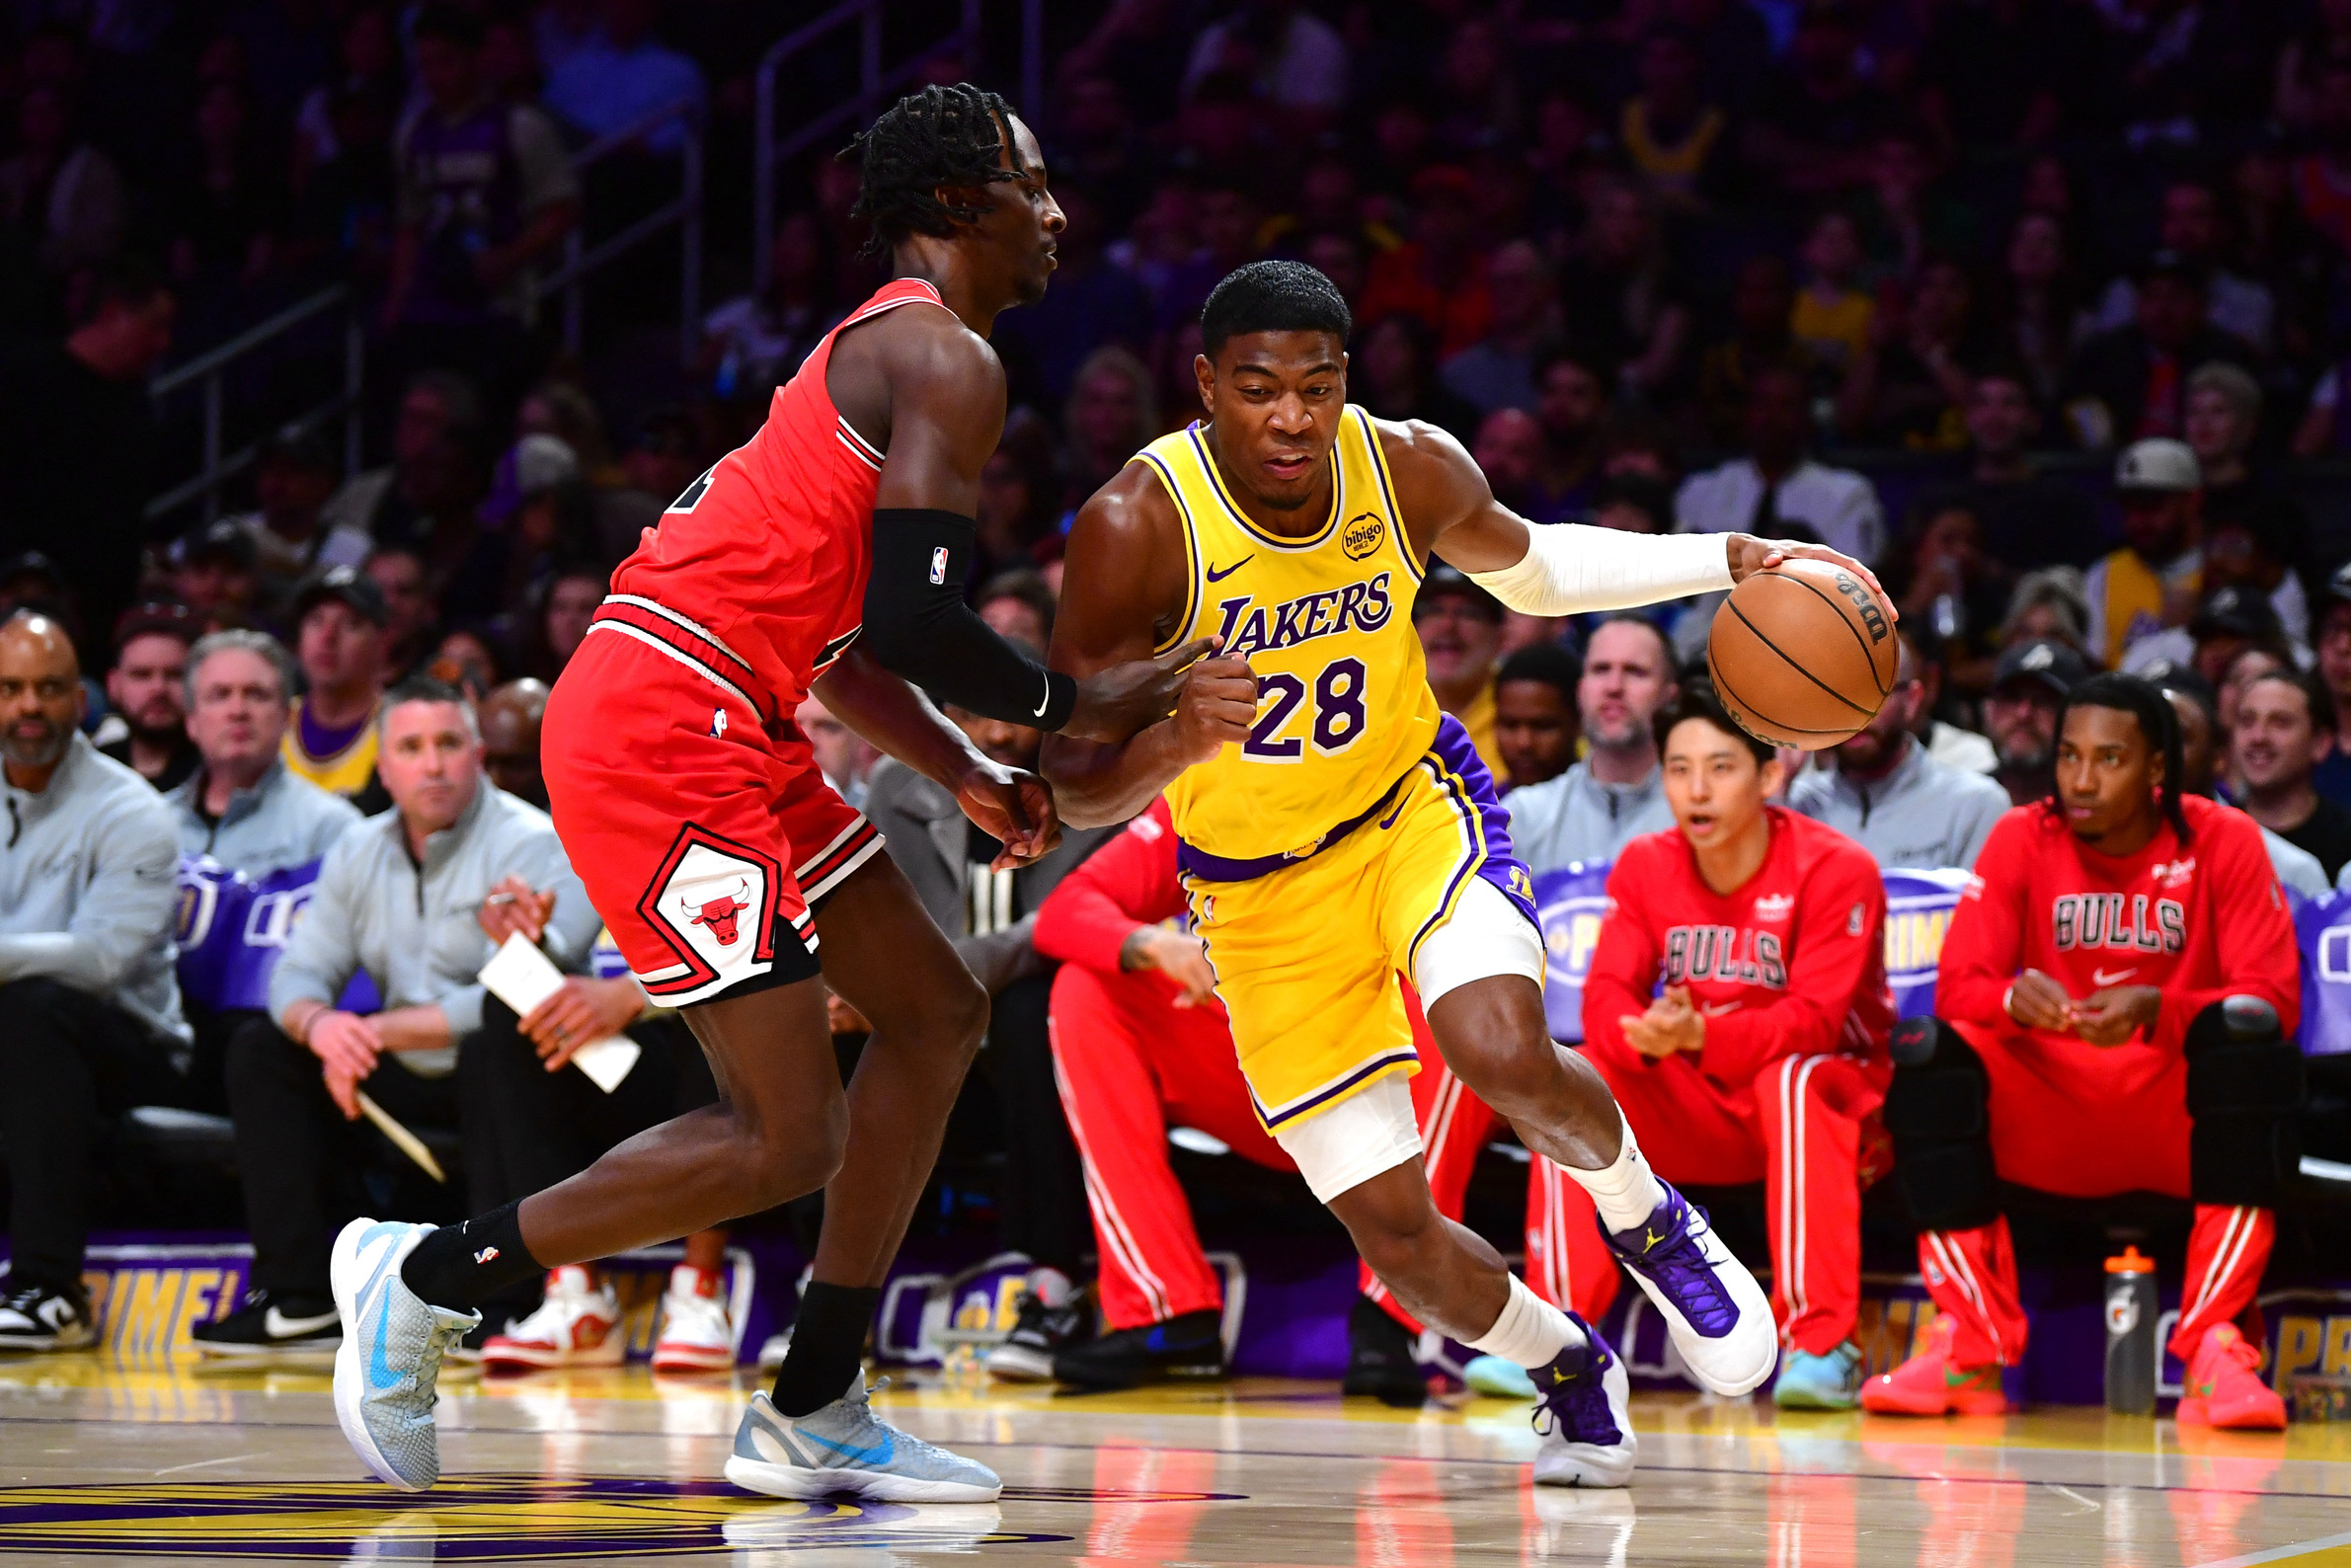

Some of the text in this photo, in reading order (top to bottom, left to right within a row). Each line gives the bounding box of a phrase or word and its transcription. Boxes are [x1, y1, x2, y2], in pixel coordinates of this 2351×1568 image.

[1345, 523, 1382, 547] bibigo
[1207, 571, 1394, 661] LAKERS
[1829, 569, 1888, 646] Wils
[1240, 656, 1367, 763] 28
[1664, 923, 1787, 990] BULLS
[2052, 892, 2186, 956] BULLS
